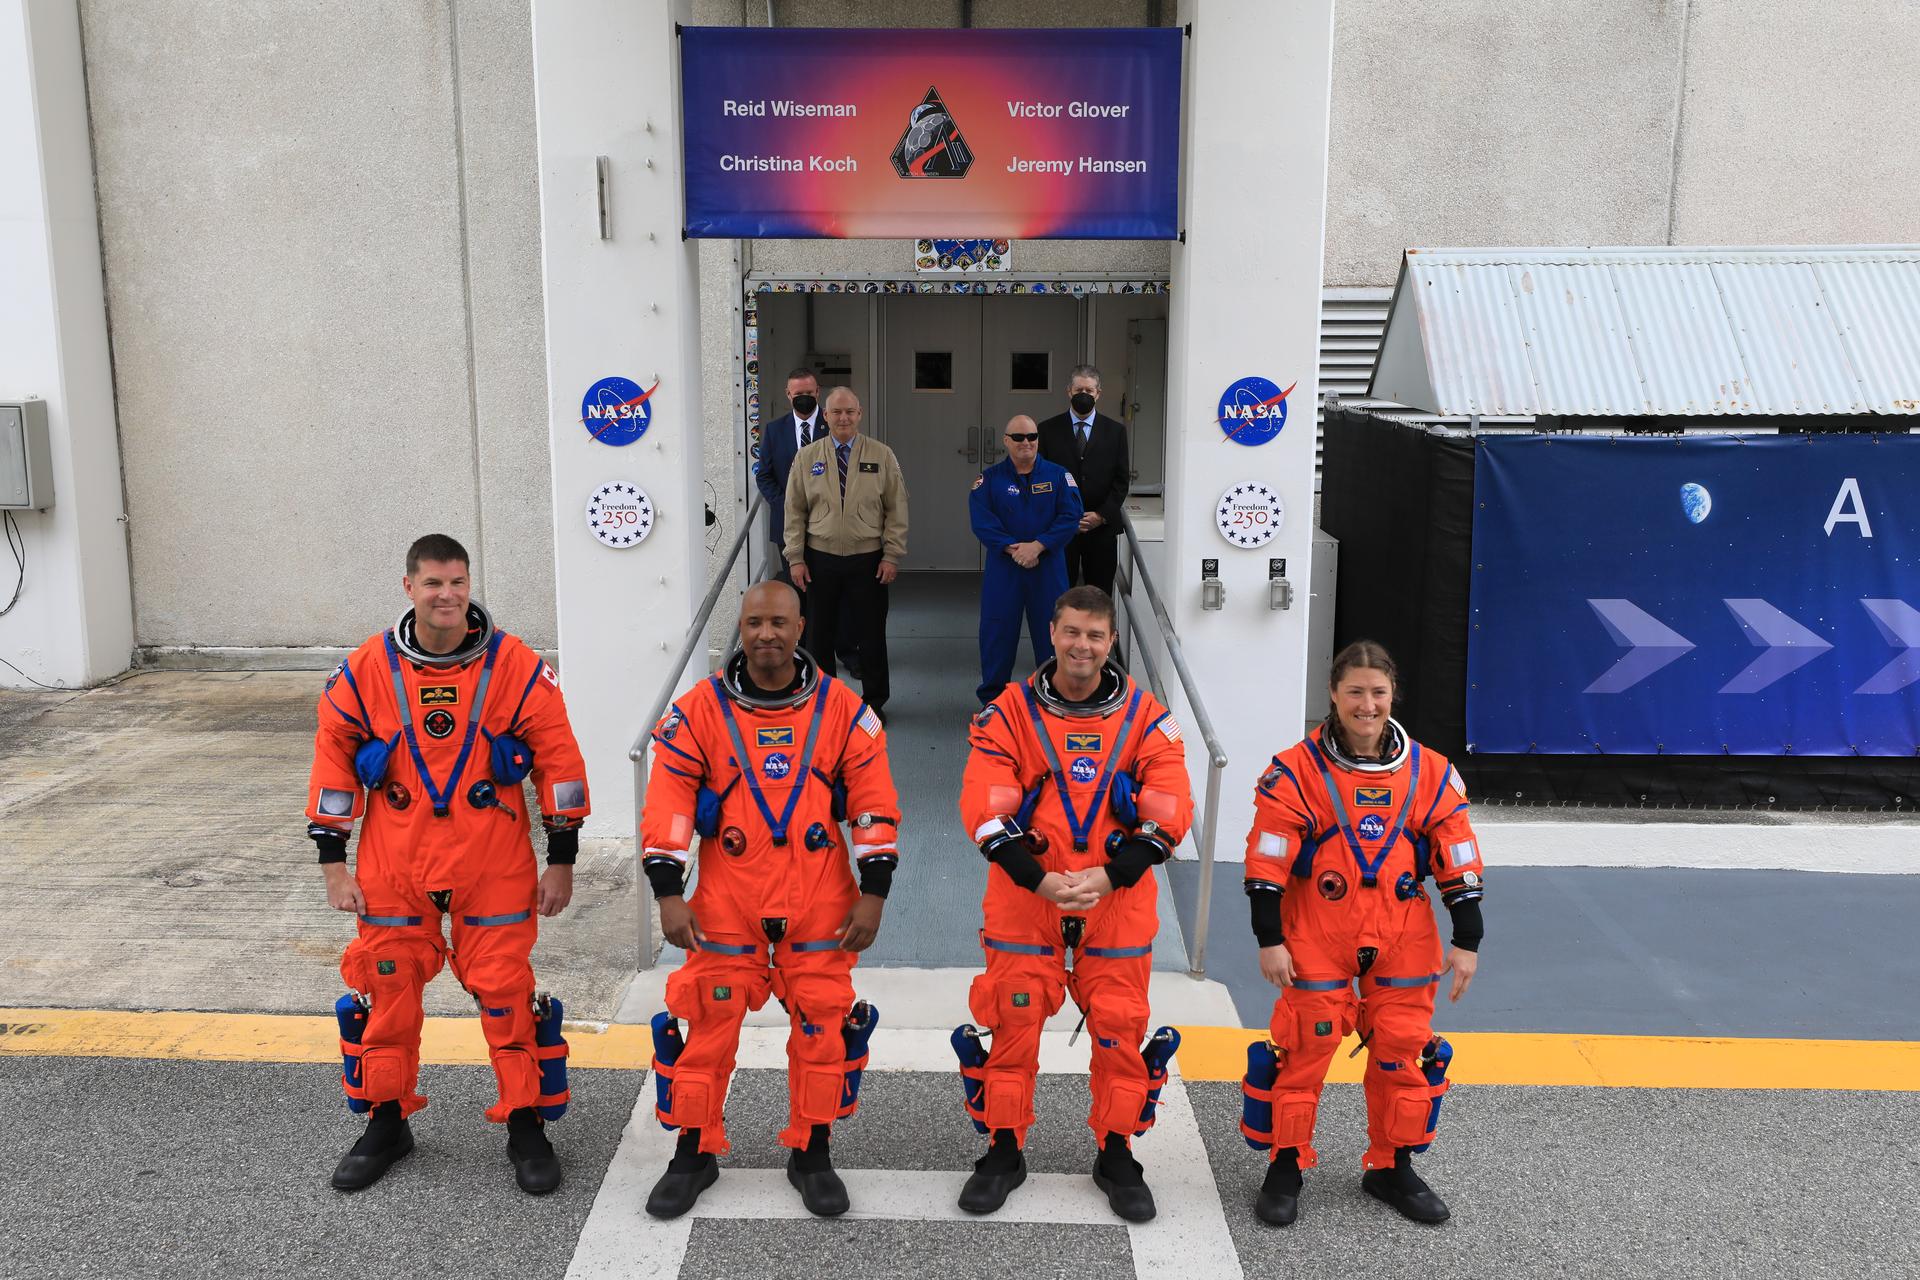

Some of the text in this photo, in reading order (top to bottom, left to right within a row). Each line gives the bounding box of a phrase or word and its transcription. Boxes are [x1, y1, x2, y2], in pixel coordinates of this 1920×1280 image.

[723, 100, 857, 117] Reid Wiseman
[1007, 101, 1130, 118] Victor Glover
[719, 155, 857, 172] Christina Koch
[1006, 156, 1147, 176] Jeremy Hansen
[587, 404, 648, 419] NASA
[1224, 404, 1283, 419] NASA
[1232, 503, 1268, 511] Freedom
[1823, 477, 1873, 538] A
[602, 511, 638, 529] 250
[1232, 511, 1268, 529] 250
[765, 762, 789, 770] NASA
[1072, 765, 1096, 774] NASA
[1360, 823, 1384, 831] NASA
